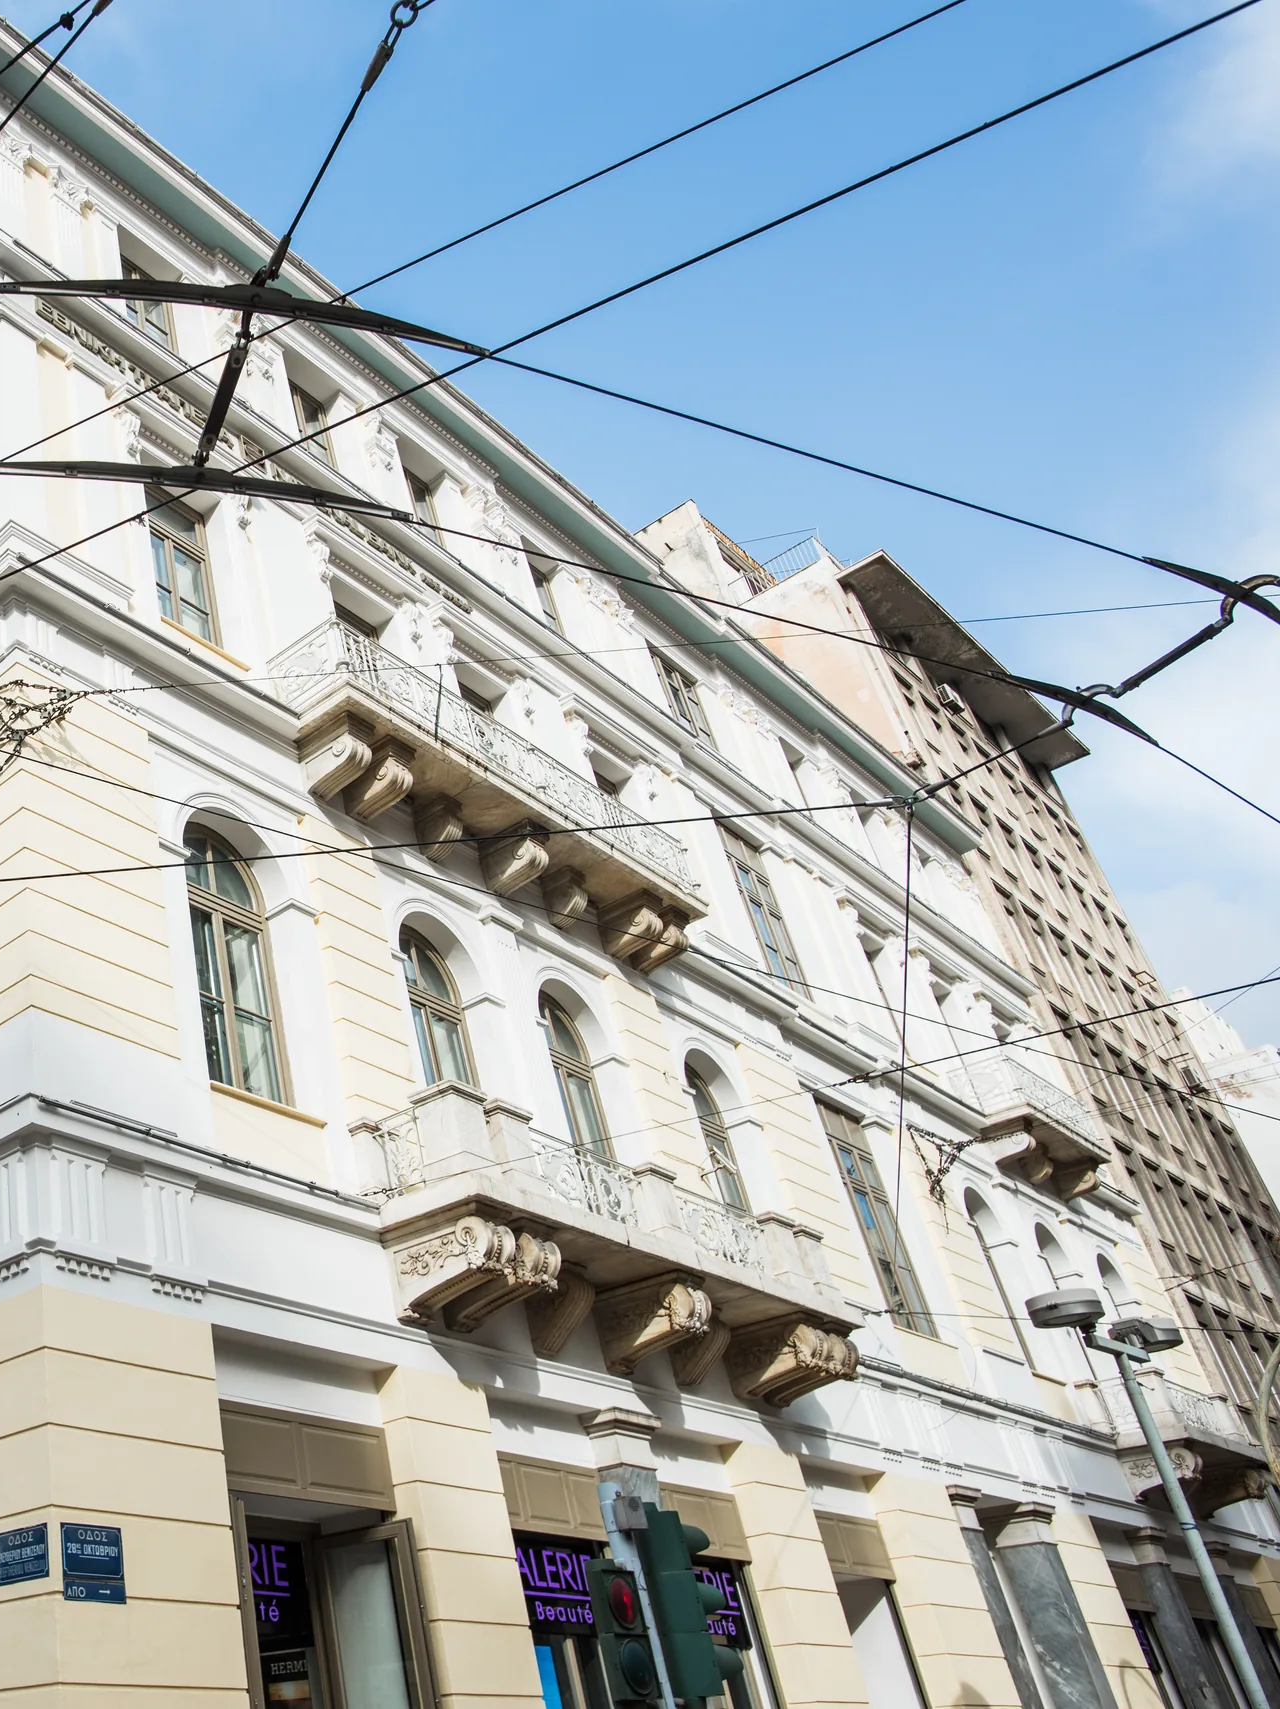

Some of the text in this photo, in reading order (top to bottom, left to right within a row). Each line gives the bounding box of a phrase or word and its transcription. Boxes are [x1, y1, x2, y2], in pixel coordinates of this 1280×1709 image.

[125, 361, 234, 450] ΤΡΑΠΕΑ
[8, 1531, 34, 1546] ΟΔΟΣ
[78, 1529, 108, 1542] ΟΔΟΣ
[67, 1586, 86, 1598] ΑΠΟ
[535, 1601, 594, 1624] Beauté
[270, 1659, 309, 1675] HERM
